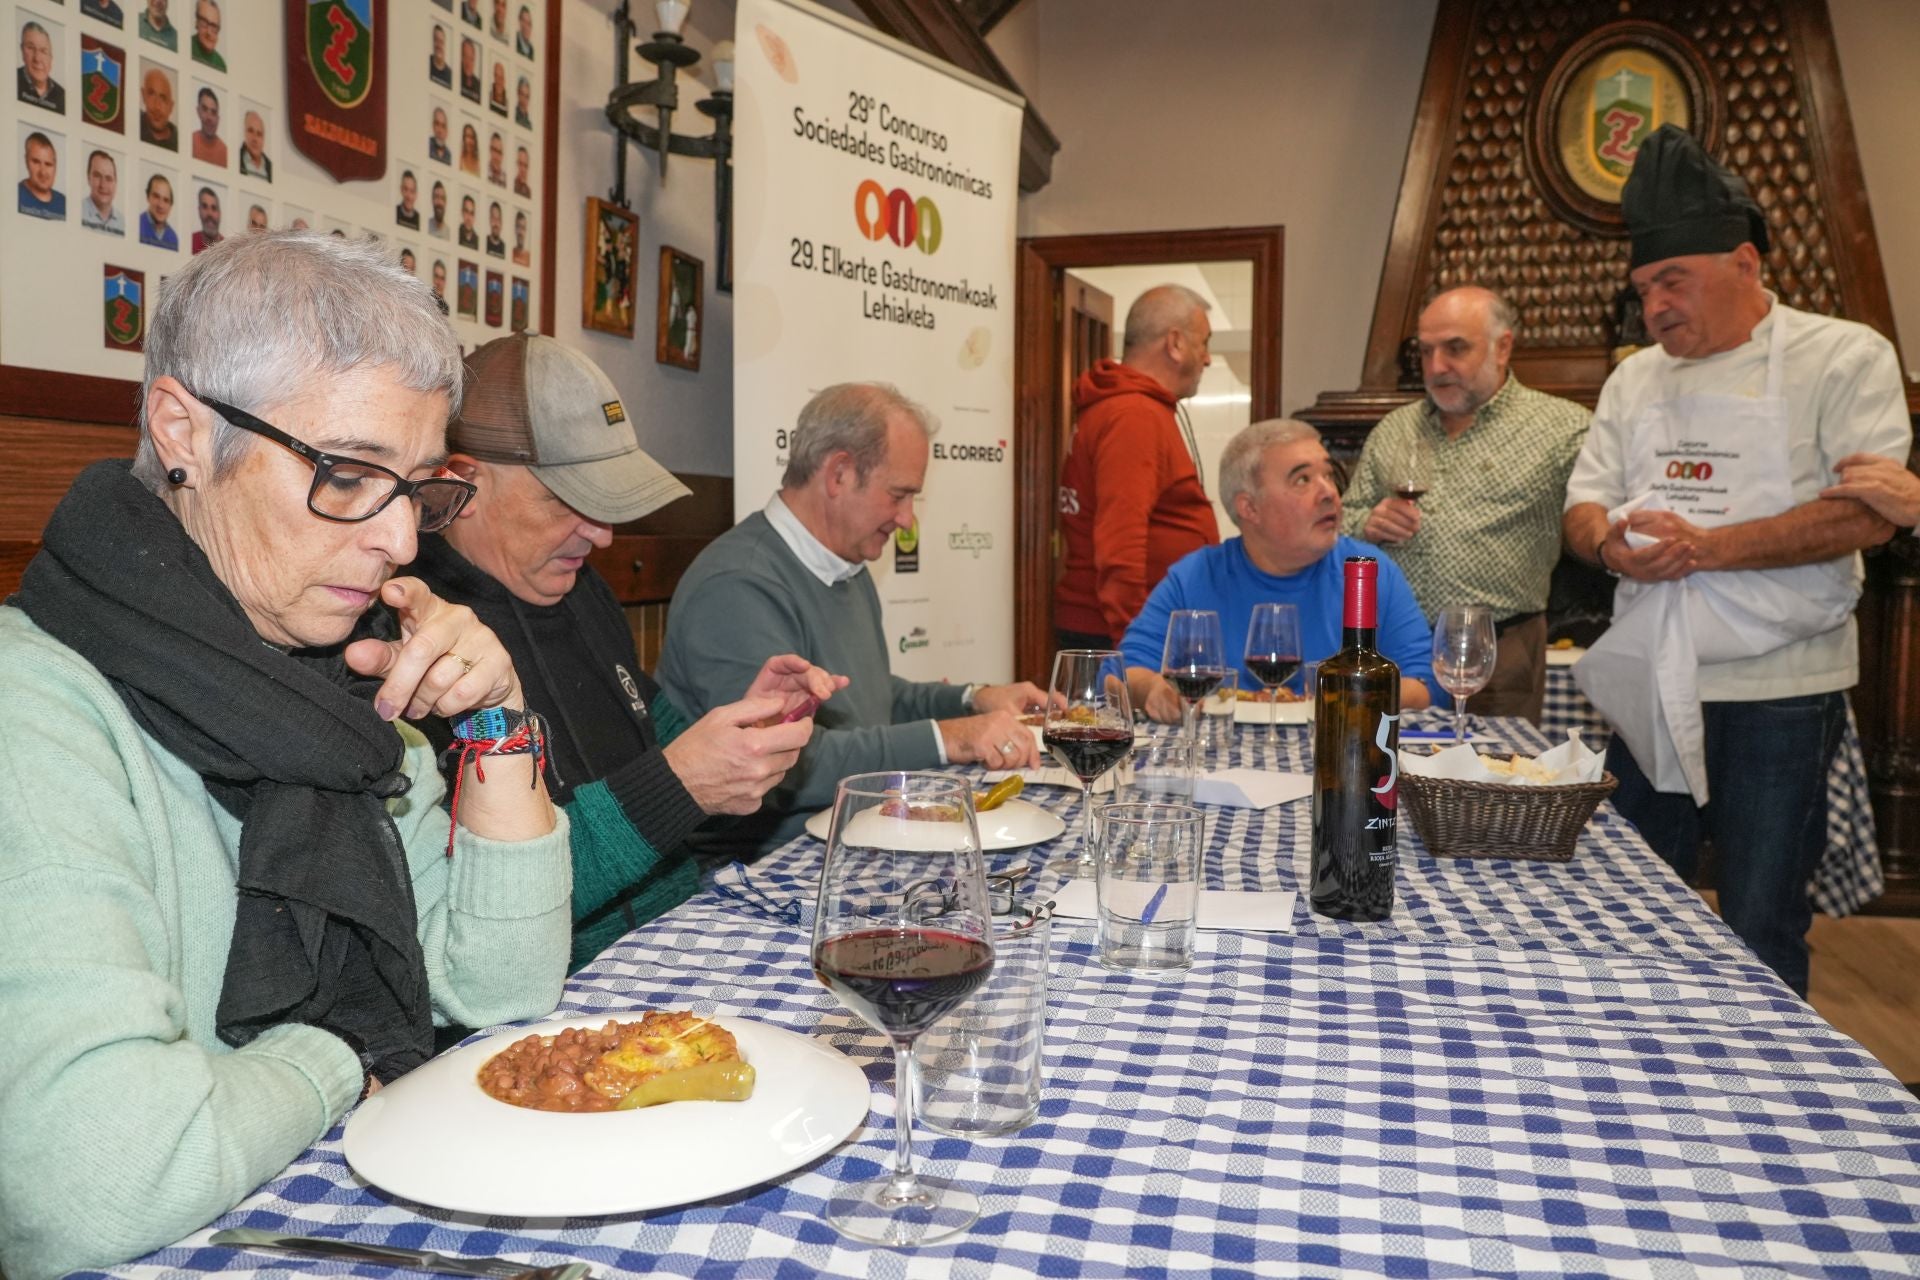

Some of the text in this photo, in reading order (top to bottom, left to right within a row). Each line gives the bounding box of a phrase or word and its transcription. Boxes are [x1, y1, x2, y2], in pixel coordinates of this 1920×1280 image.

[879, 103, 948, 152] Concurso
[793, 106, 993, 199] Sociedades Gastronómicas
[791, 238, 997, 310] 29. Elkarte Gastronomikoak
[863, 291, 935, 330] Lehiaketa
[934, 443, 1004, 463] EL CORREO
